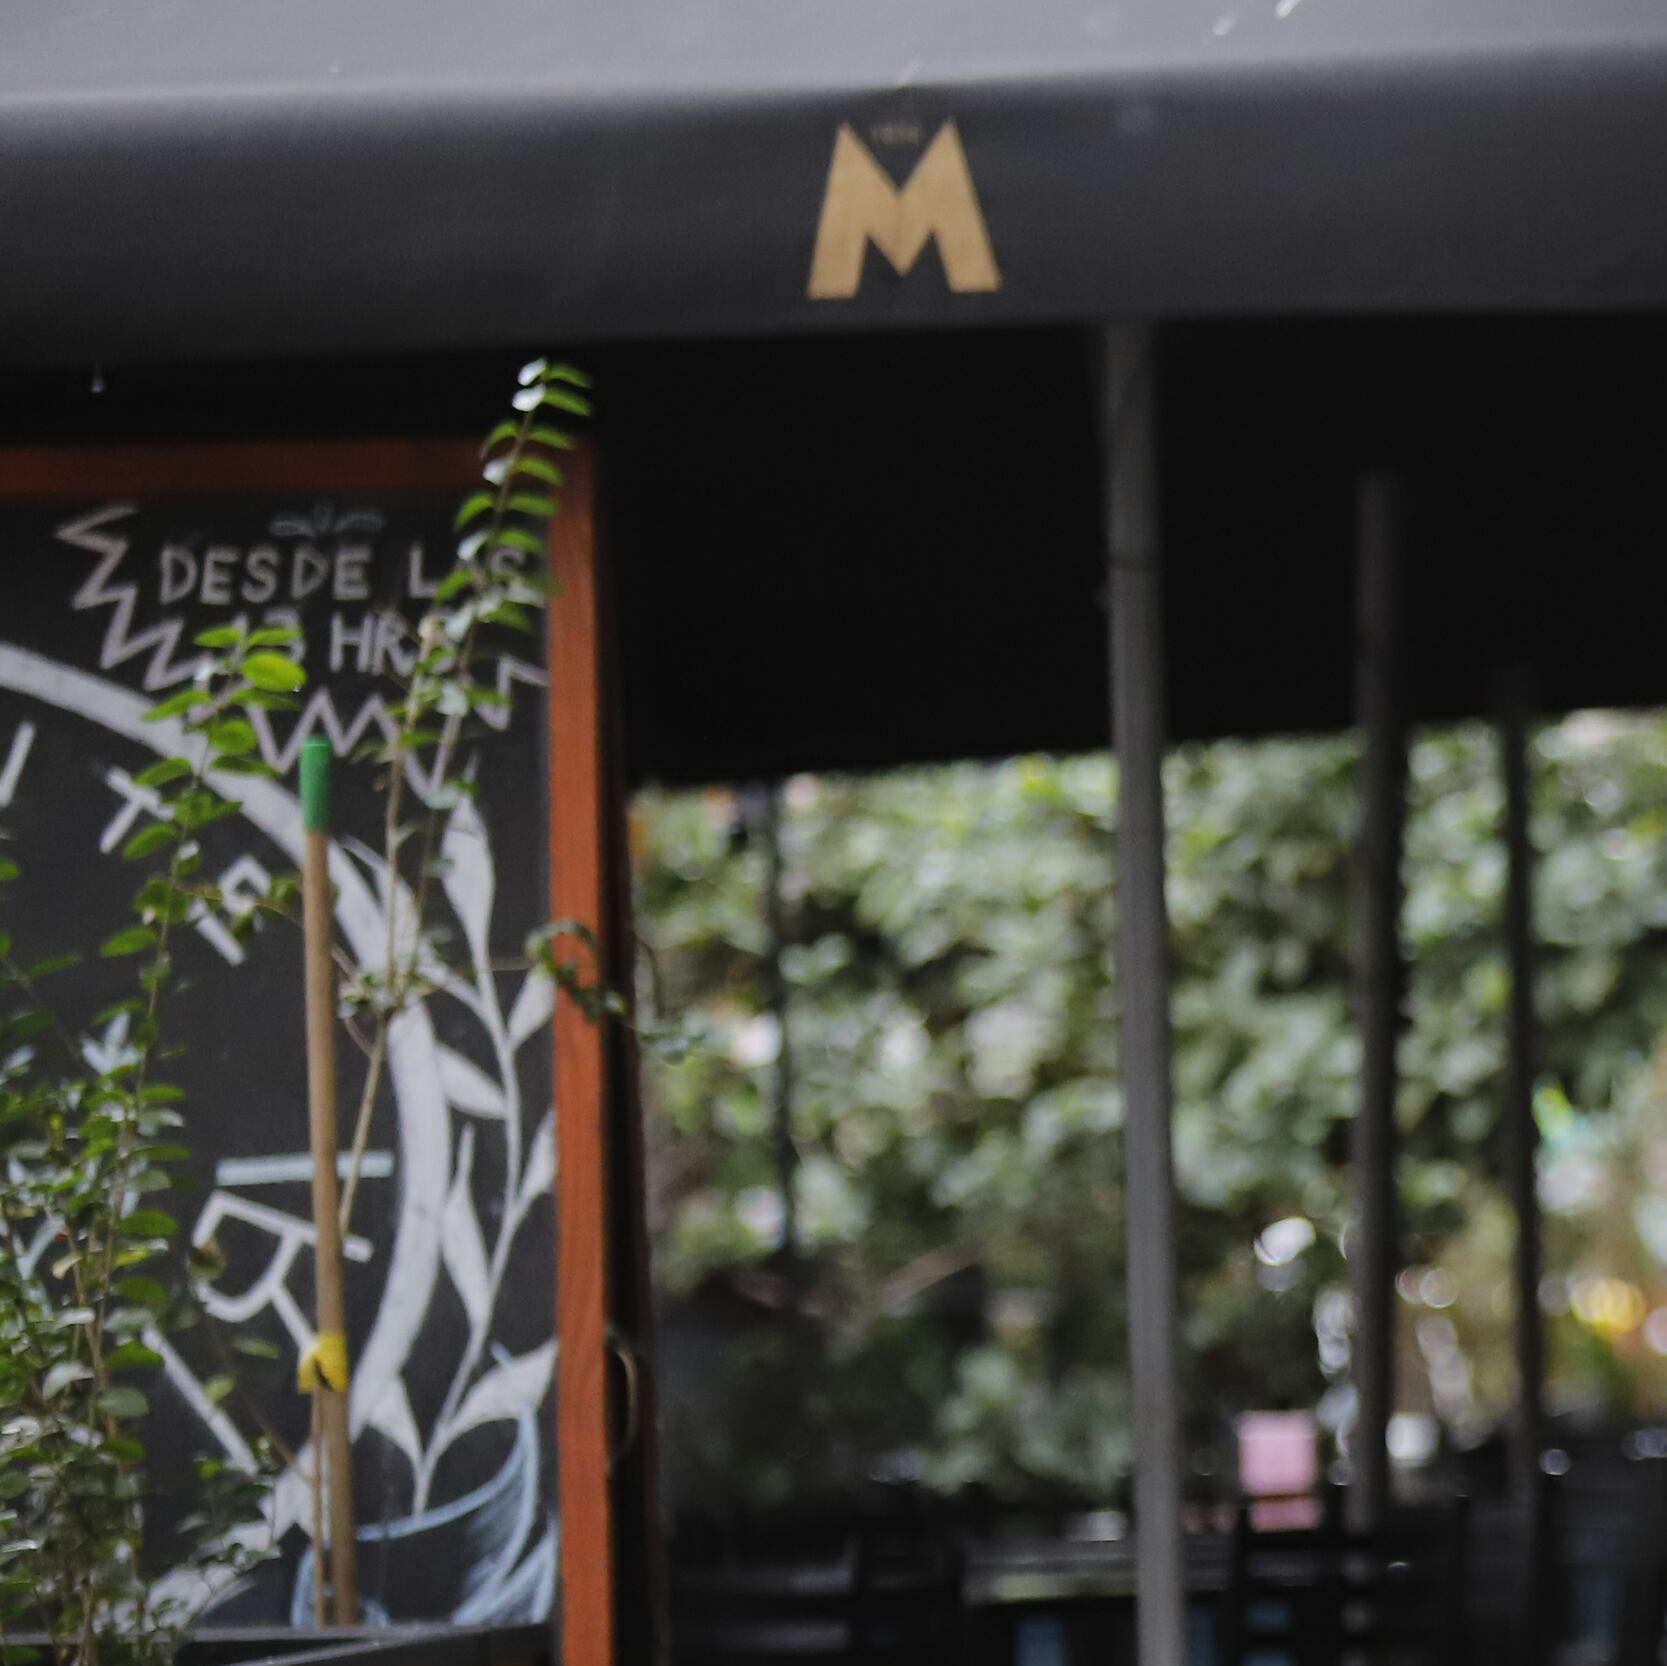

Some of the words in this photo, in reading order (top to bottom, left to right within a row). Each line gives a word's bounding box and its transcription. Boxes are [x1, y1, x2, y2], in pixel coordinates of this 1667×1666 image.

[806, 117, 1001, 299] M
[160, 543, 373, 604] DESDE
[409, 542, 525, 598] LS
